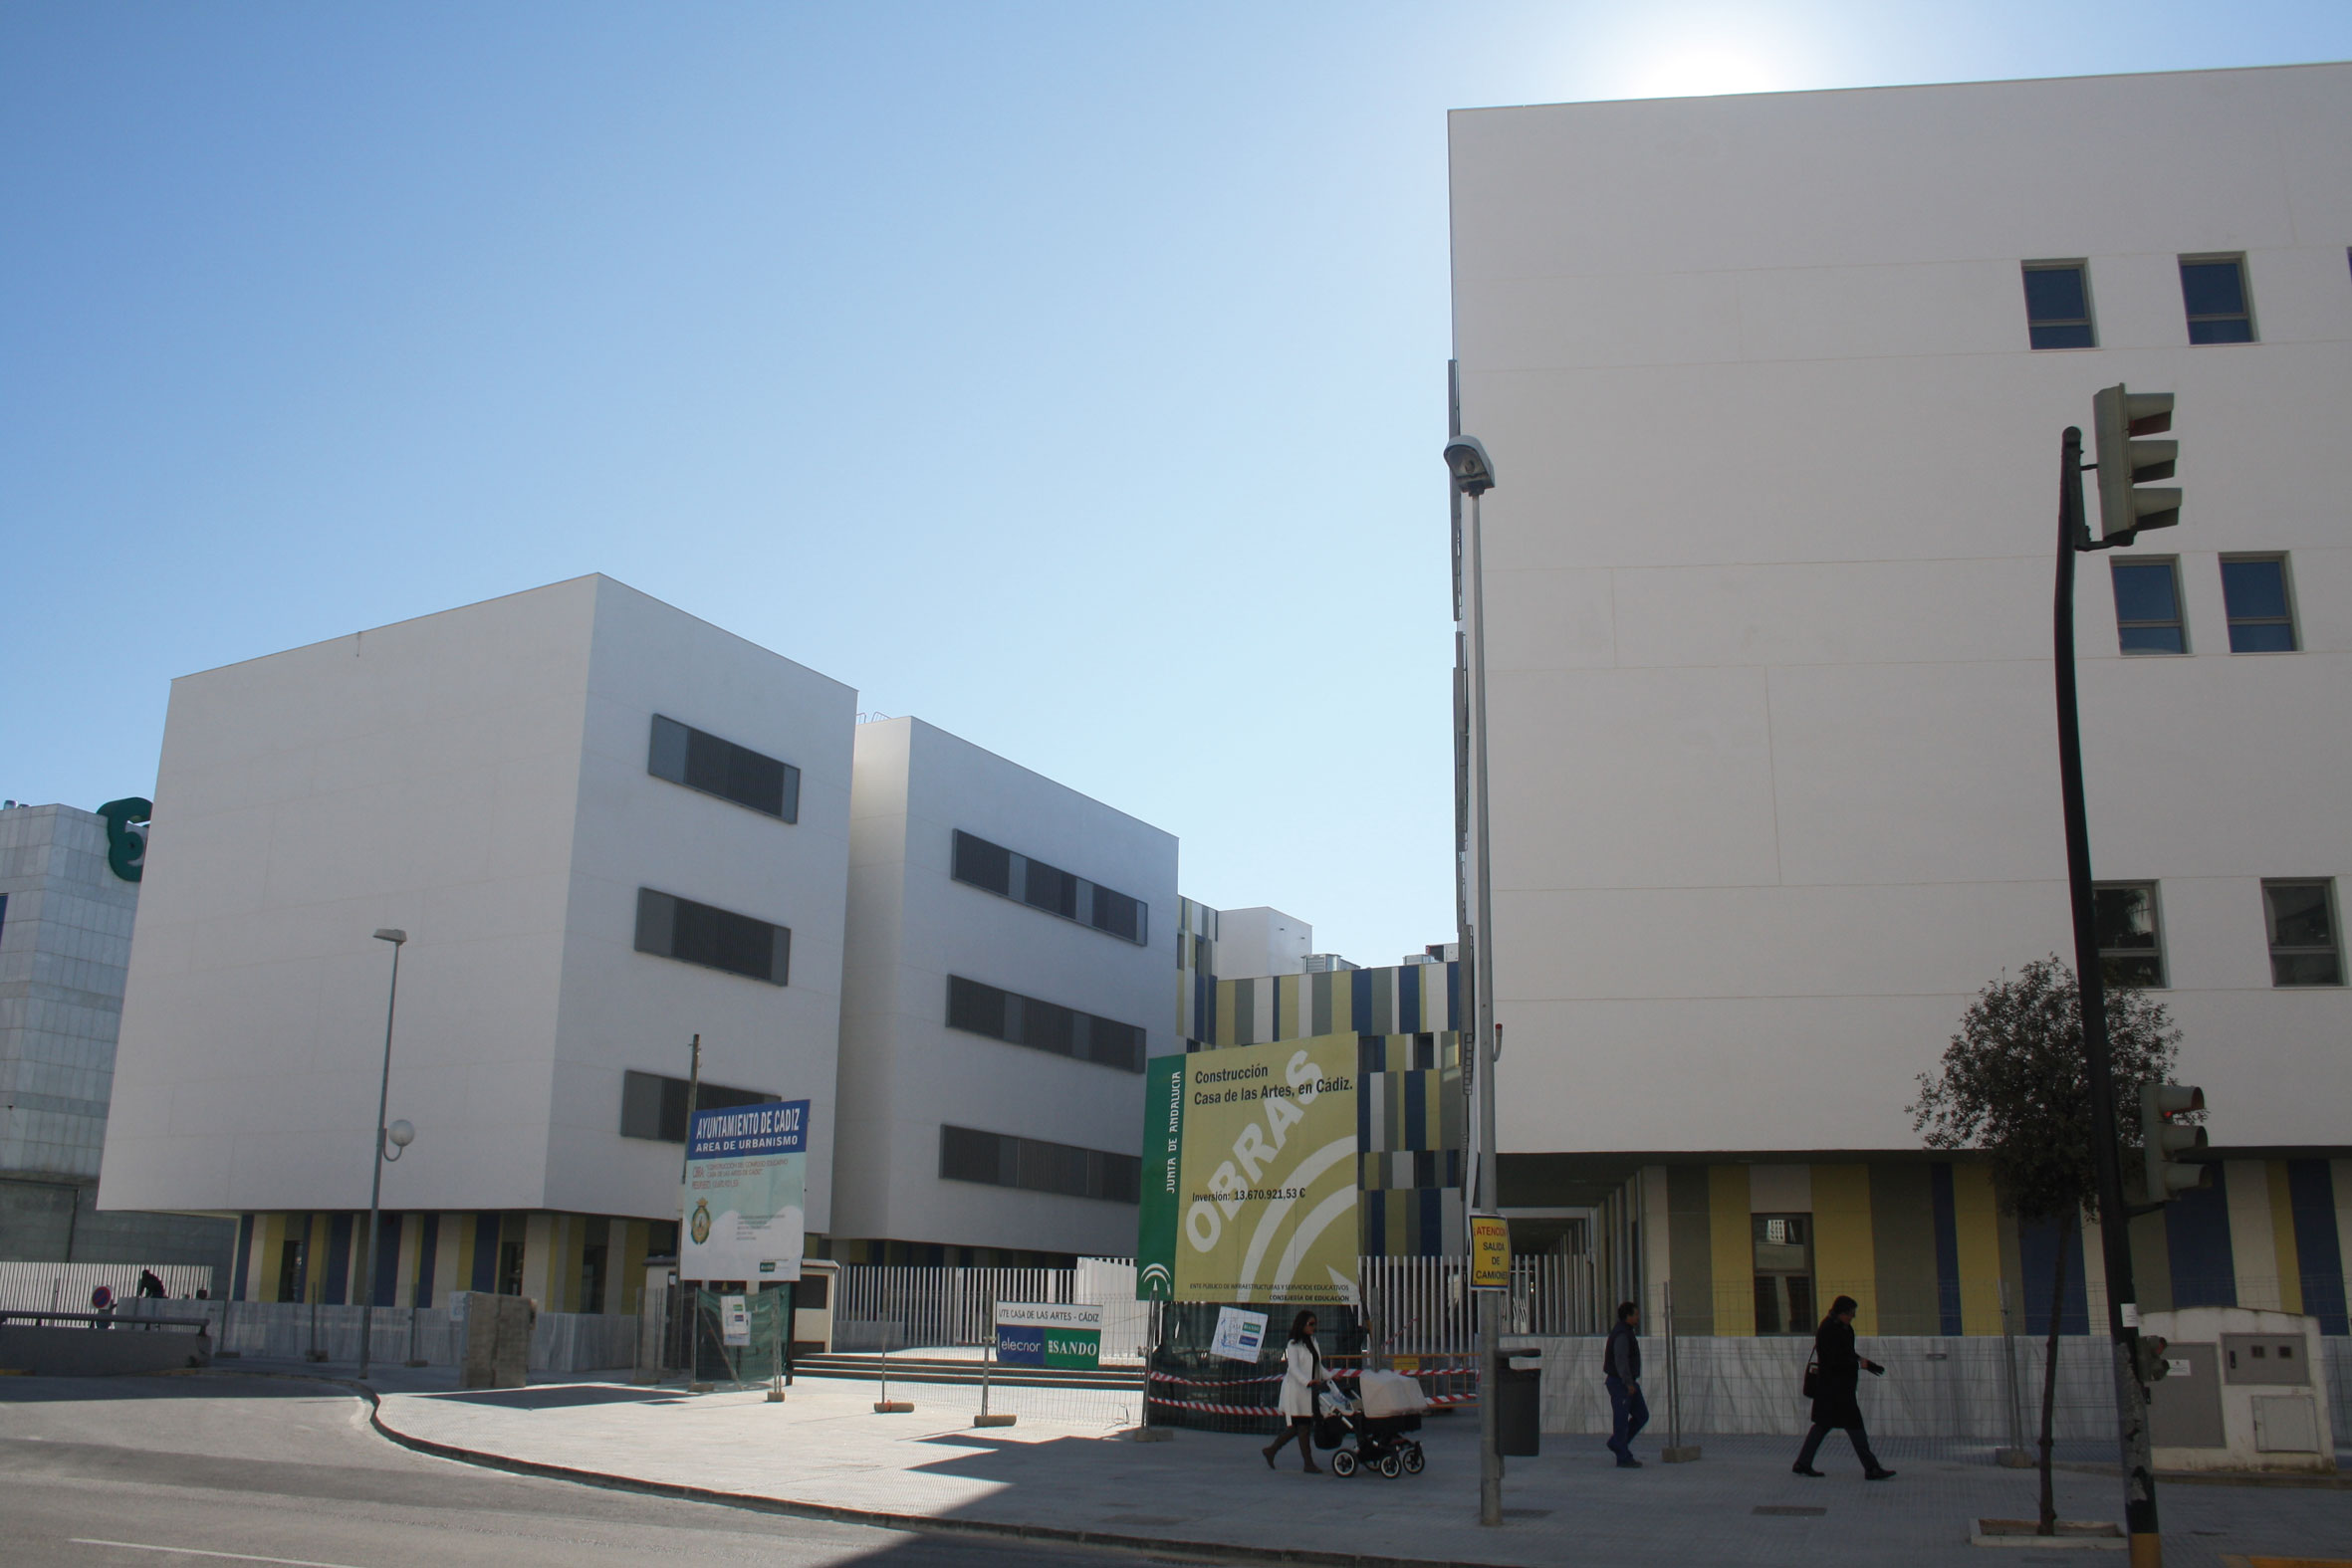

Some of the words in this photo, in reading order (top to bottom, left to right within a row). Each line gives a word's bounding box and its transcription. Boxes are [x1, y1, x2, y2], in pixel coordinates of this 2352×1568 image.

[1196, 1063, 1269, 1084] Construcción
[1195, 1091, 1221, 1105] Casa
[1225, 1089, 1238, 1102] de
[1241, 1088, 1258, 1101] las
[1261, 1084, 1294, 1098] Artes,
[1298, 1083, 1312, 1095] en
[1316, 1076, 1353, 1093] Cádiz.
[696, 1112, 759, 1140] AYUNTAMIENTO
[761, 1111, 772, 1135] DE
[696, 1143, 721, 1153] AREA
[724, 1141, 736, 1150] DE
[739, 1135, 798, 1150] URBANISMO
[1168, 1138, 1178, 1153] DE
[1186, 1049, 1323, 1253] OBRAS
[1167, 1157, 1177, 1194] JUNTA
[1192, 1191, 1231, 1203] Inversión:
[1234, 1189, 1297, 1201] 13.670.921,53
[1299, 1188, 1306, 1199] €
[1492, 1256, 1501, 1265] DE
[1011, 1309, 1027, 1319] CASA
[1027, 1310, 1036, 1319] DE
[1037, 1311, 1049, 1320] LAS
[1050, 1312, 1072, 1322] ARTES
[1078, 1312, 1099, 1323] CÁDIZ
[1002, 1337, 1042, 1353] elecnor
[1053, 1340, 1097, 1357] SANDO
